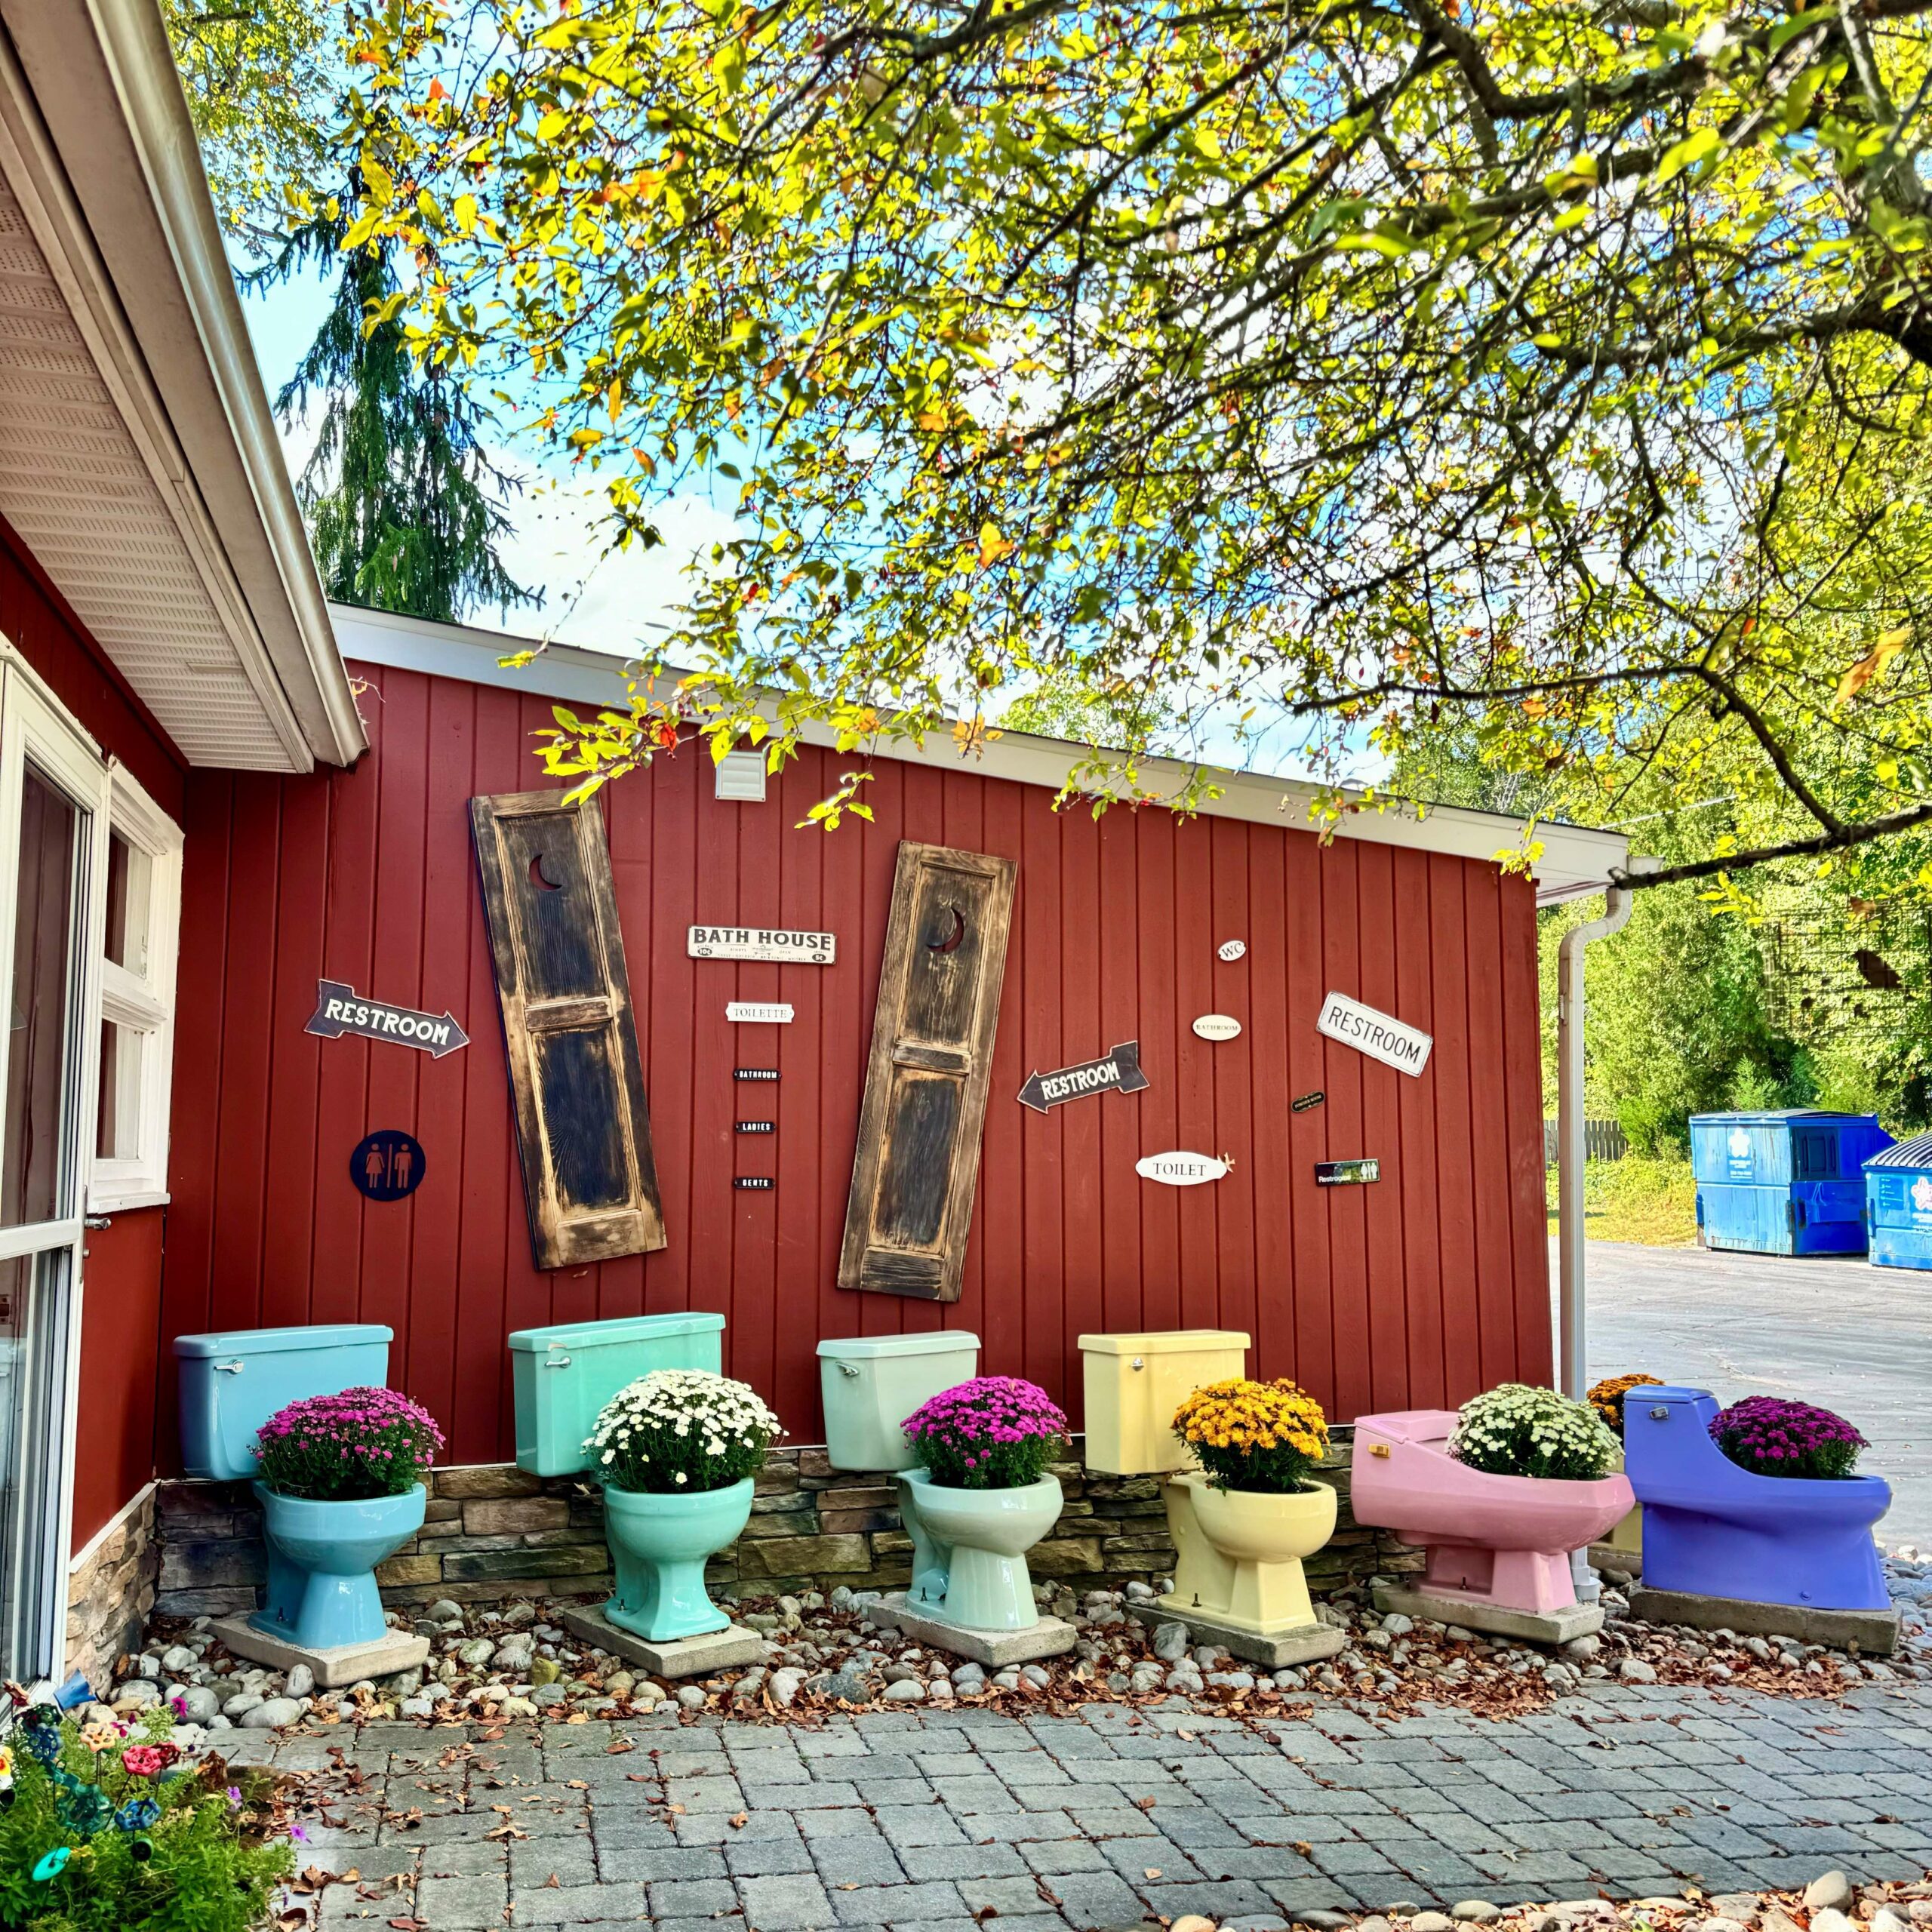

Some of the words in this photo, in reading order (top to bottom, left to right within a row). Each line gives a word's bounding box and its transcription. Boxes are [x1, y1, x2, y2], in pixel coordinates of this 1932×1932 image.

[694, 928, 749, 943] BATH
[758, 931, 831, 950] HOUSE
[1222, 943, 1243, 957] WC
[734, 1008, 787, 1018] TOILETTE
[325, 998, 450, 1045] RESTROOM
[1328, 1006, 1421, 1063] RESTROOM
[739, 1070, 777, 1078] BATHROOM
[1040, 1061, 1121, 1100] RESTROOM
[742, 1122, 771, 1131] LADIES
[1152, 1163, 1207, 1177] TOILET
[742, 1179, 768, 1187] GENTS
[1318, 1175, 1352, 1183] Restrooms
